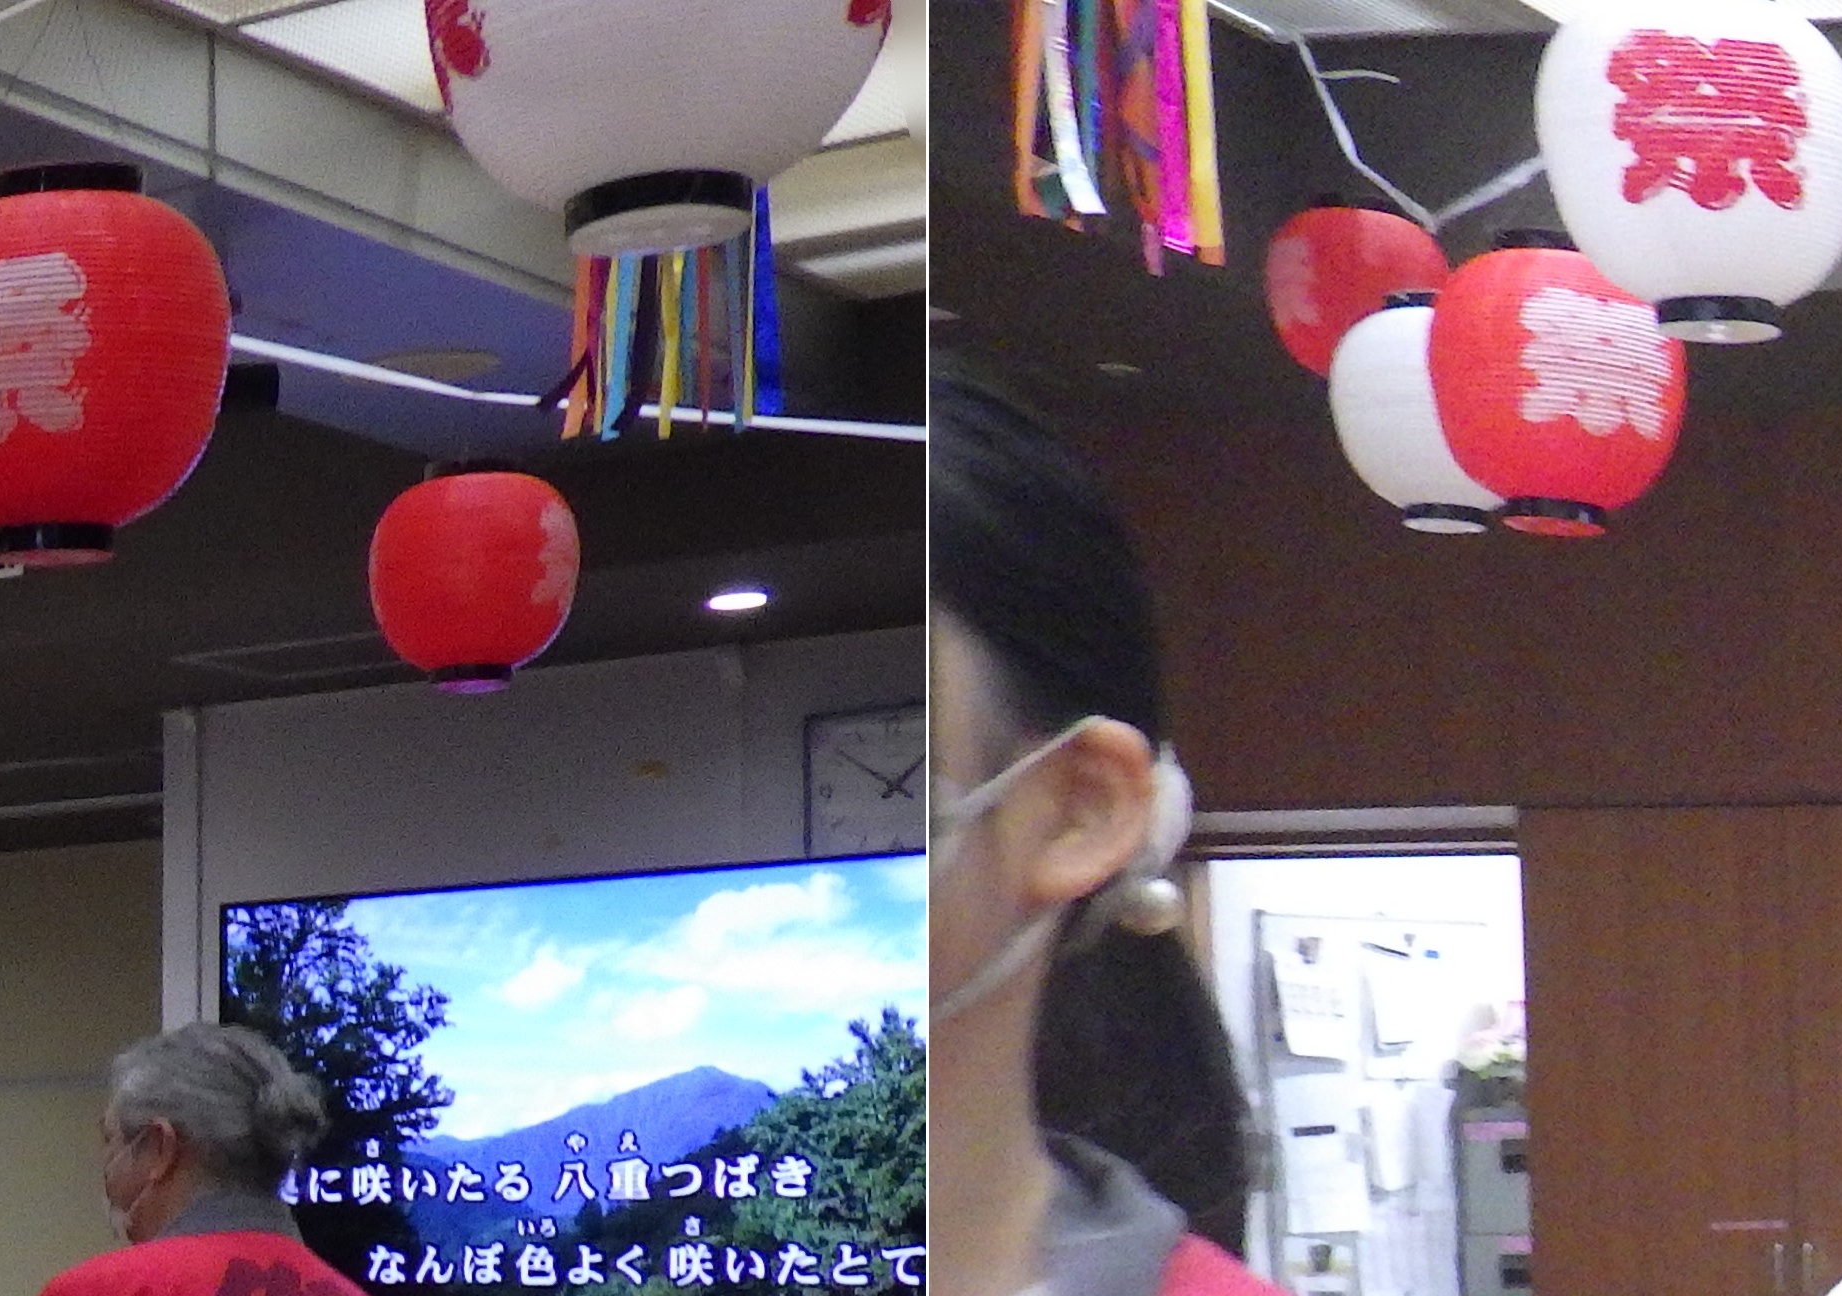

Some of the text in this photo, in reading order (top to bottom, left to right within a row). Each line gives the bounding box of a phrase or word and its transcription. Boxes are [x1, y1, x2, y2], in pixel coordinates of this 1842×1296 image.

[1607, 29, 1807, 210] 祭
[1520, 287, 1673, 441] 祭
[553, 1154, 813, 1201] 八重つばき
[669, 1243, 927, 1287] 咲いたとて
